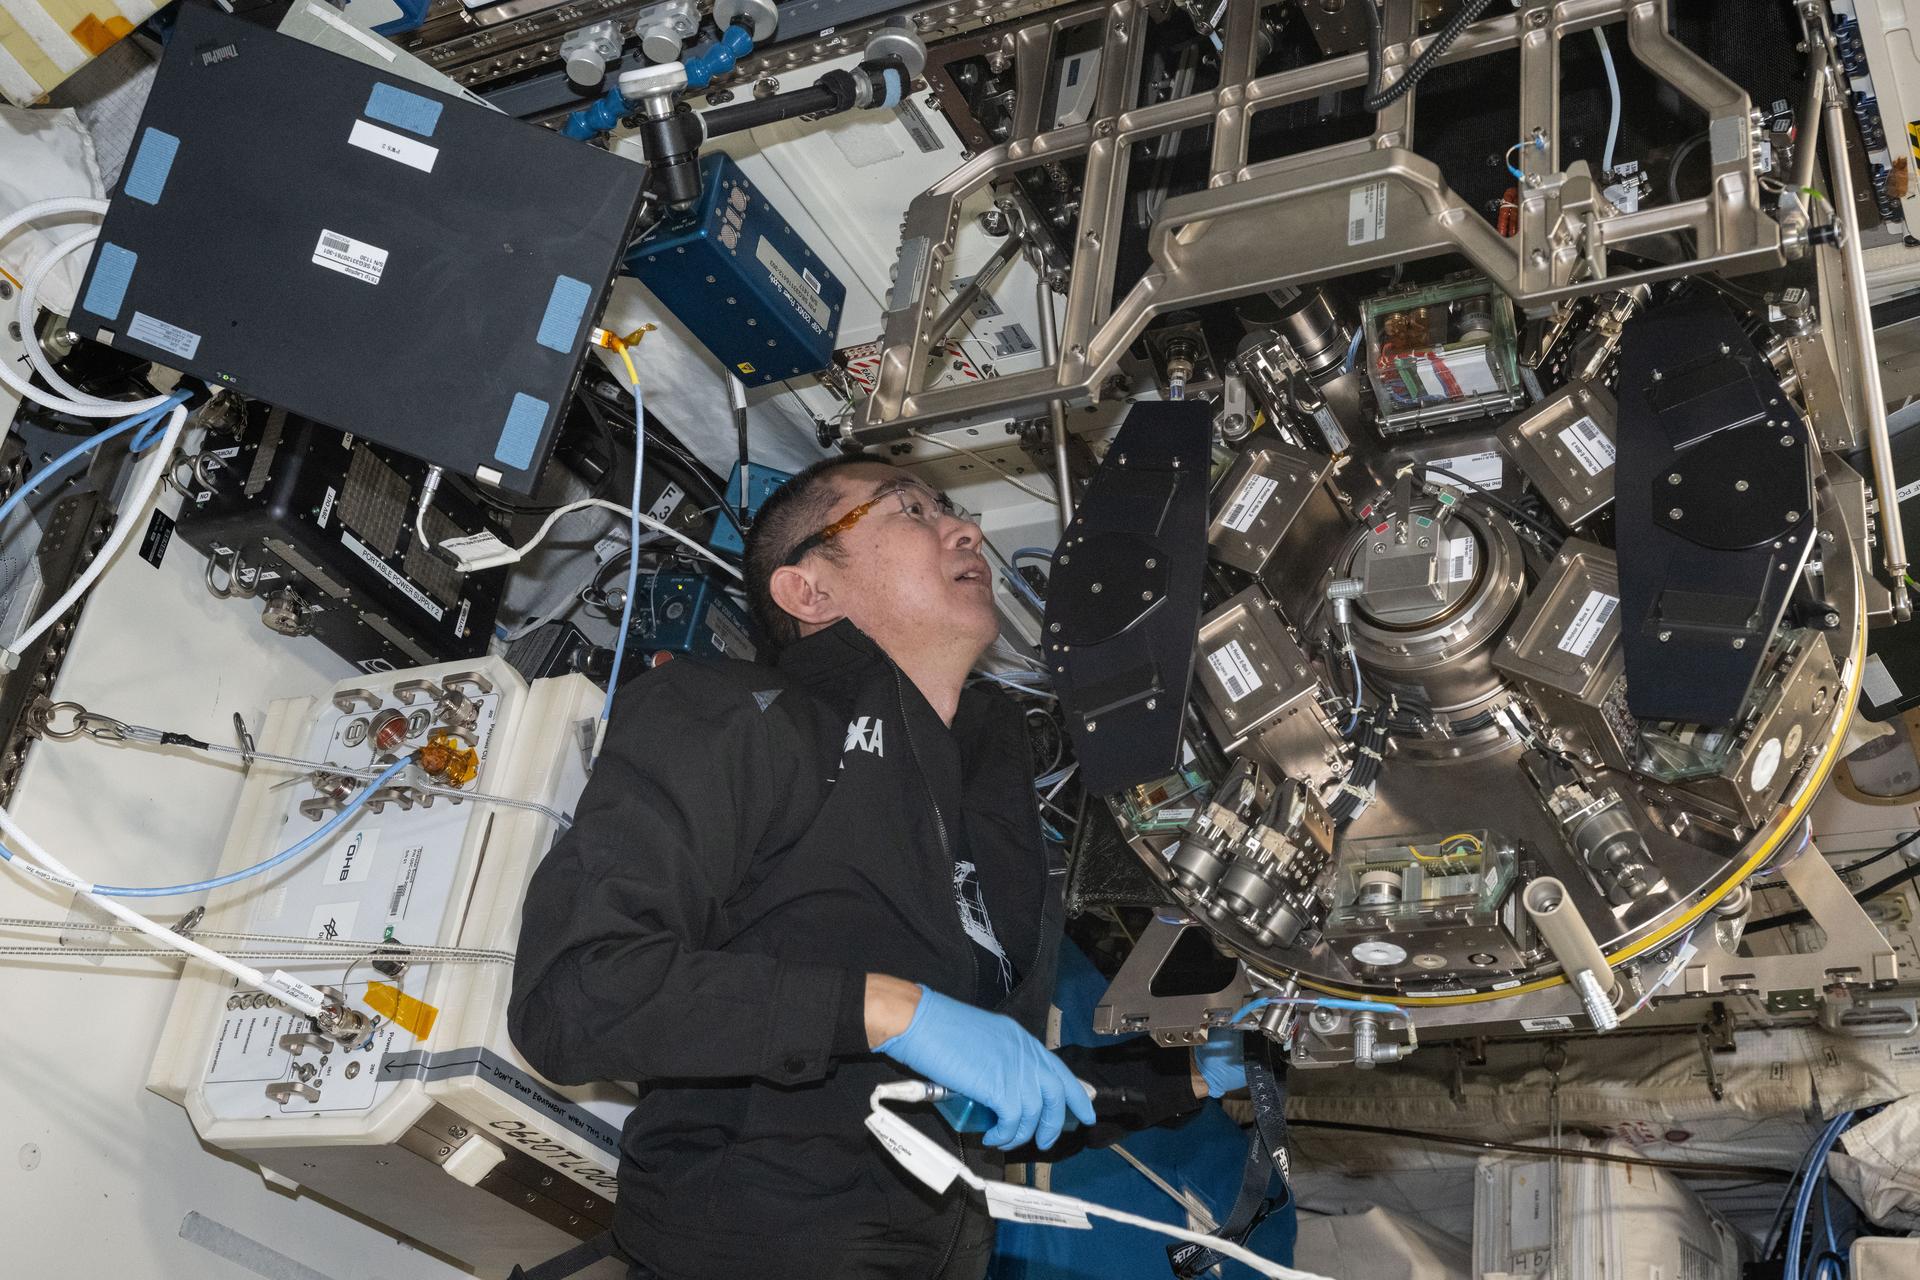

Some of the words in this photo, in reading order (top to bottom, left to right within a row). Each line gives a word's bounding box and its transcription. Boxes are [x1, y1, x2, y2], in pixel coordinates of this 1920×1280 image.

[200, 43, 241, 67] ThinkPad
[343, 266, 364, 278] Laptop
[370, 264, 382, 273] P/N
[372, 259, 384, 267] S/N
[767, 271, 783, 292] Supply
[781, 288, 797, 306] Power
[323, 493, 333, 507] OUT
[660, 485, 677, 503] F
[656, 503, 672, 521] 3
[361, 549, 393, 577] PORTABLE
[391, 574, 414, 595] POWER
[412, 592, 435, 612] SUPPLY
[1231, 648, 1242, 661] Rotor
[1238, 659, 1249, 672] E-Box
[338, 843, 357, 883] OHB
[34, 869, 50, 880] Cable
[50, 875, 74, 888] Ethernet
[241, 1016, 256, 1054] Measurement
[268, 1014, 283, 1047] Experiment
[1253, 1063, 1271, 1113] TIKKA
[515, 1080, 532, 1095] BUMP
[532, 1092, 567, 1117] EQUIPMENT
